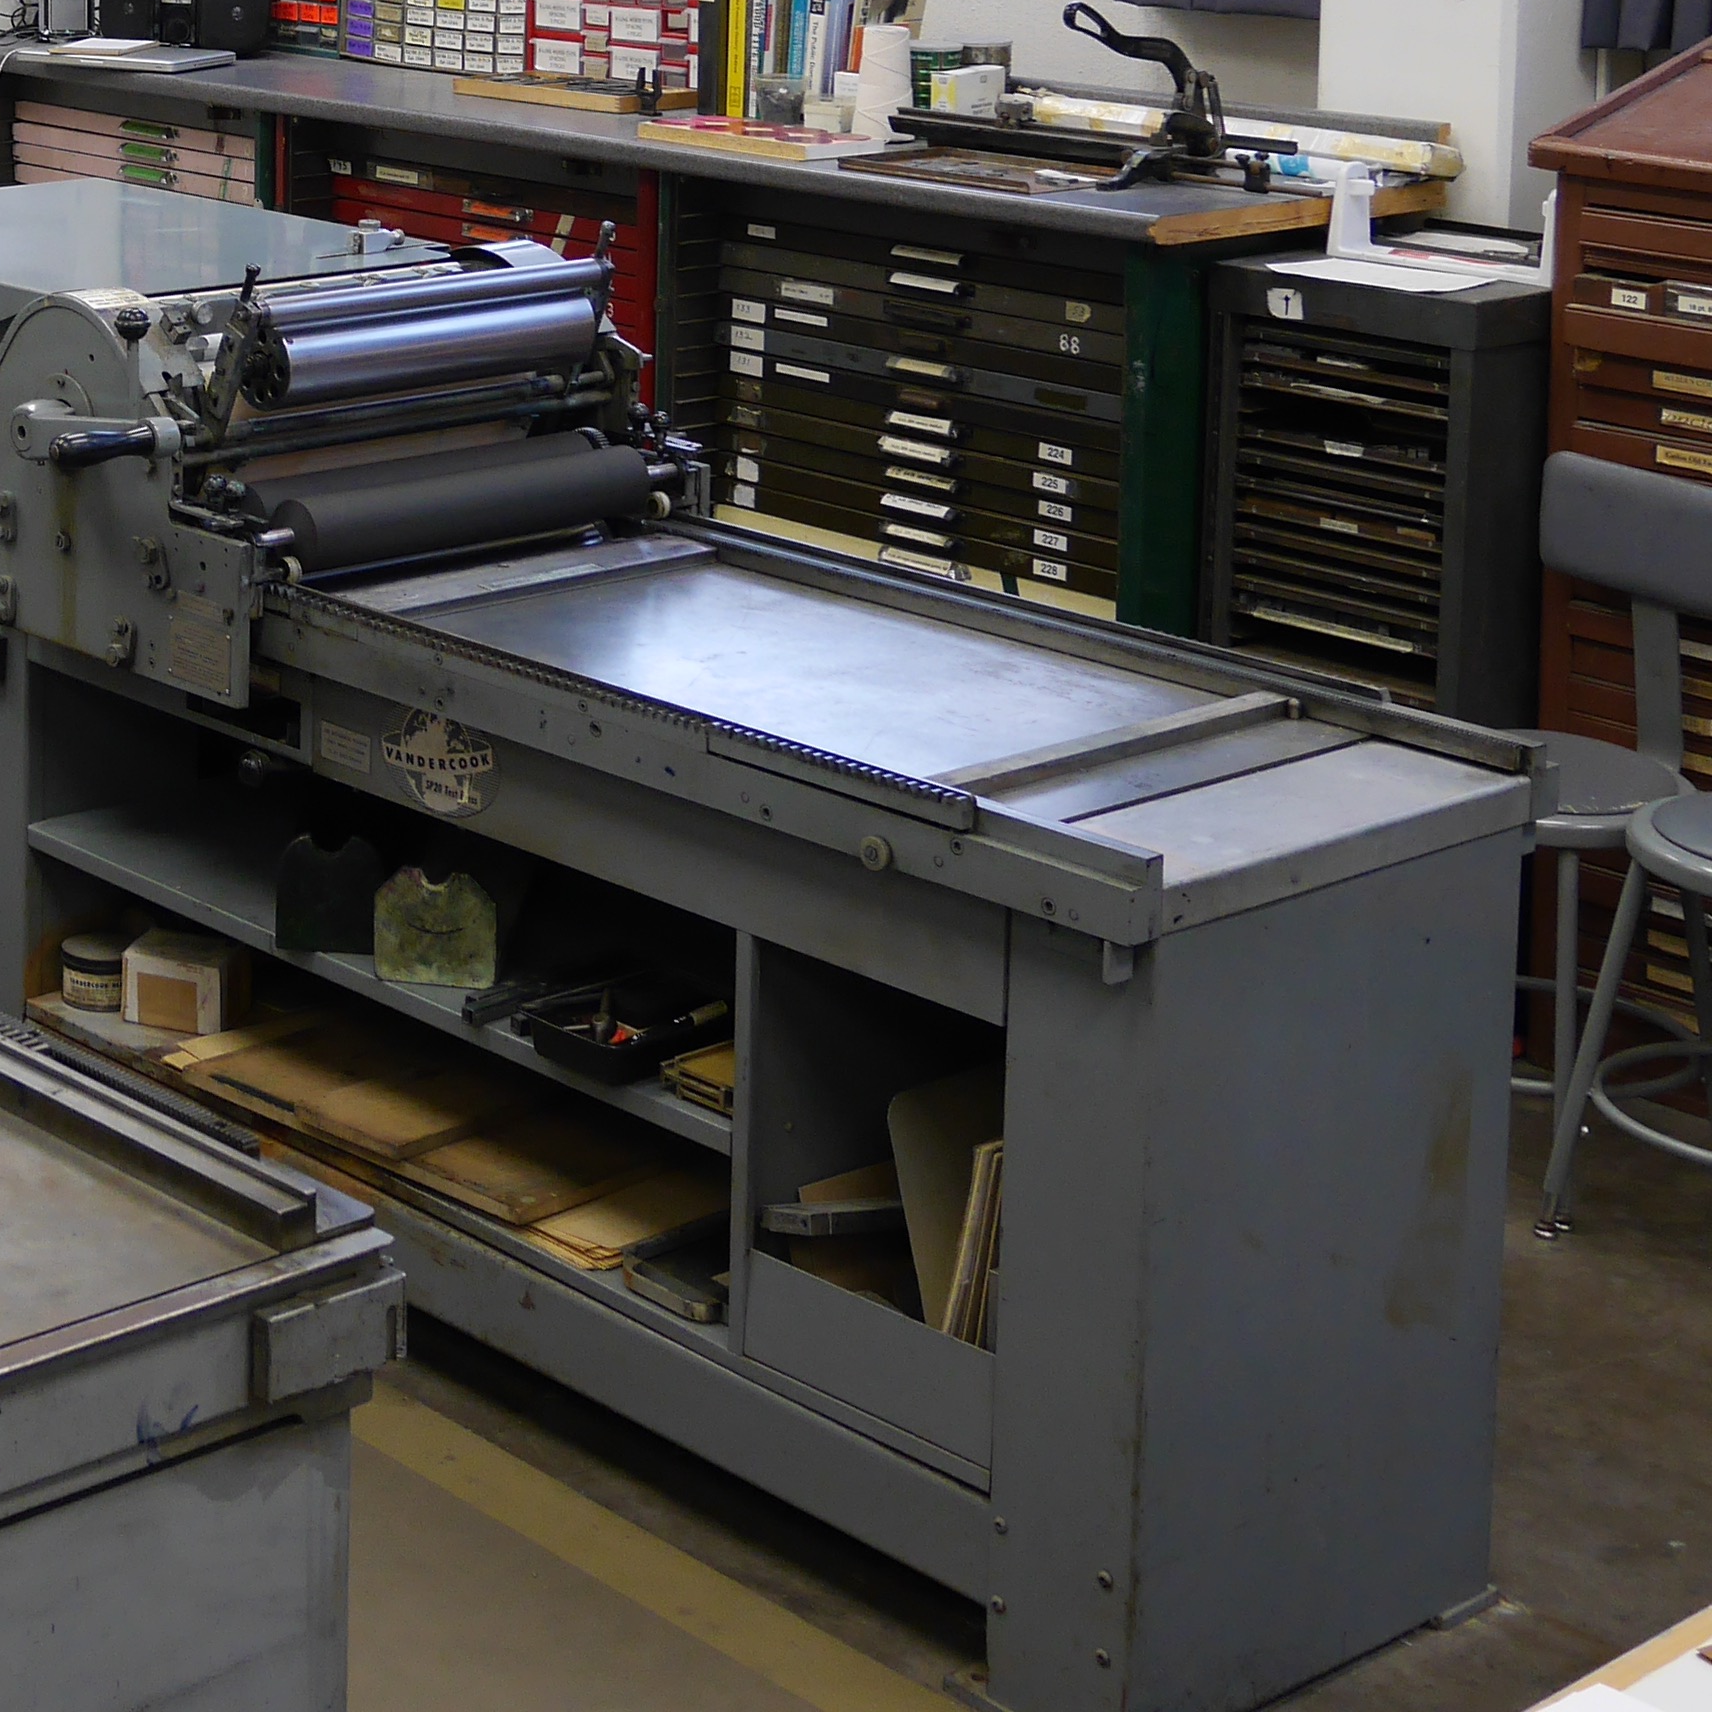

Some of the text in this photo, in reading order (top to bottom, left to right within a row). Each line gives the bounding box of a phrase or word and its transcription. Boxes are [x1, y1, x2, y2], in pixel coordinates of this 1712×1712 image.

[1621, 294, 1638, 305] 122
[1058, 332, 1081, 355] 88
[1047, 445, 1065, 461] 224
[1041, 475, 1059, 490] 225
[1046, 503, 1065, 519] 226
[1041, 532, 1060, 548] 227
[1040, 561, 1059, 577] 228
[385, 746, 490, 771] VANDERCOOK
[426, 779, 442, 795] SP20
[444, 785, 458, 800] Test
